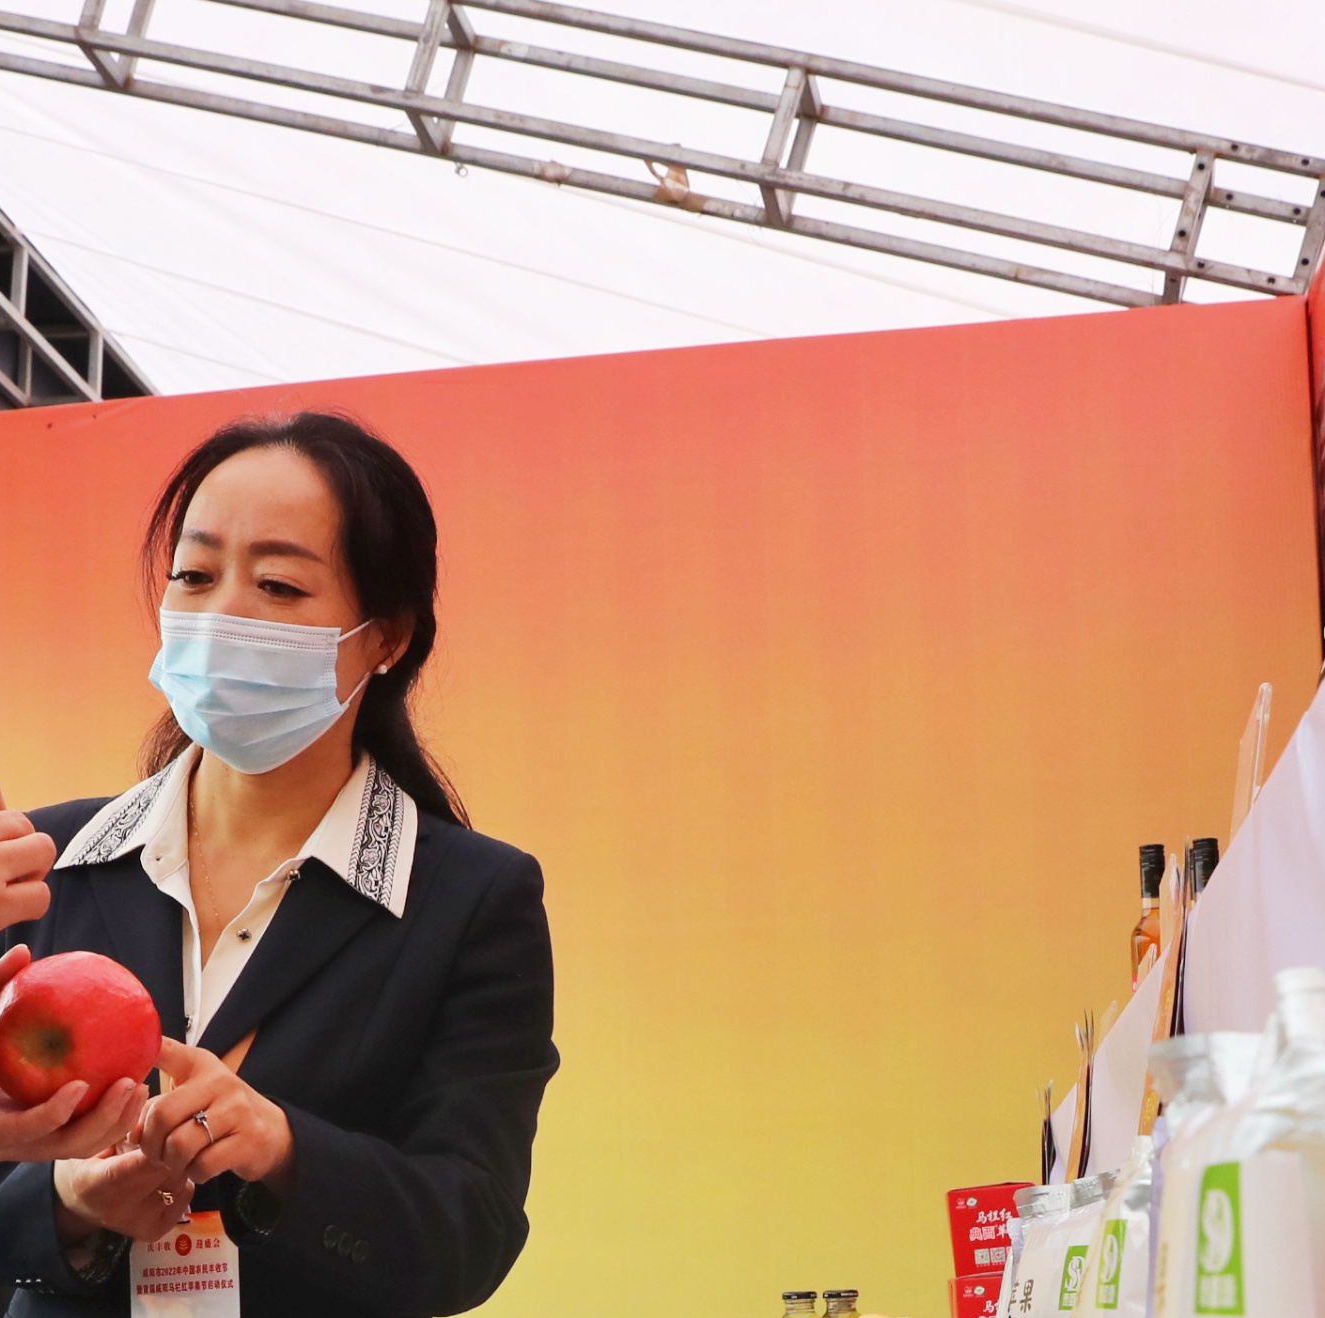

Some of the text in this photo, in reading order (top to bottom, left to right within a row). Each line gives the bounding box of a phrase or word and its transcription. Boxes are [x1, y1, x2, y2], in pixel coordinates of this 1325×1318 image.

[142, 1263, 228, 1278] 咸阳市2022年中国农民丰收节
